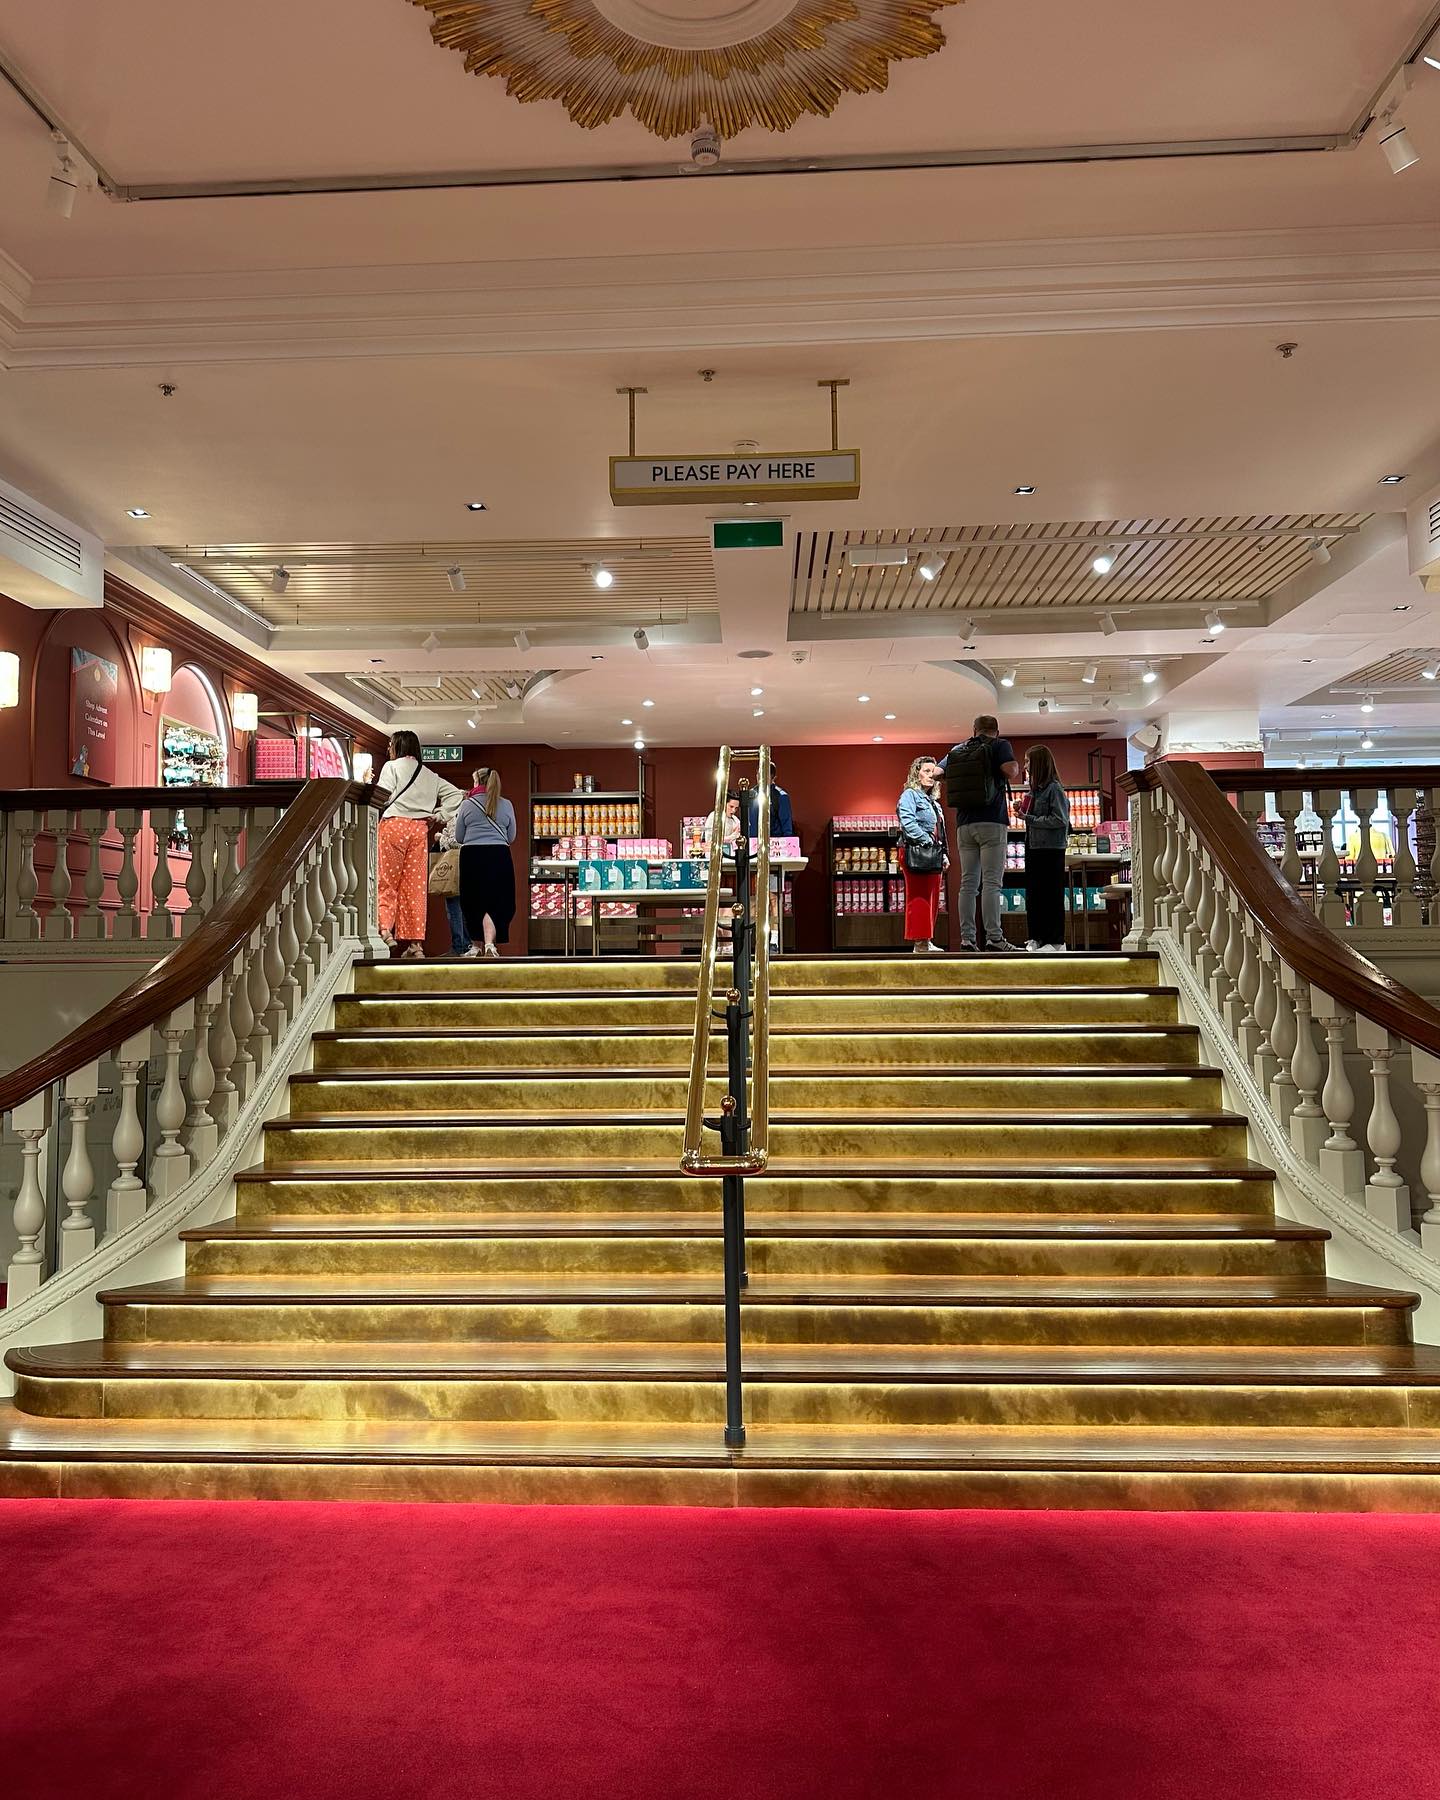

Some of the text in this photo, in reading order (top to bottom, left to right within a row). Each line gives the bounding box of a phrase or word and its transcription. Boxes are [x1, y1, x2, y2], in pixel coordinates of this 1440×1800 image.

[652, 462, 815, 482] PLEASE PAY HERE
